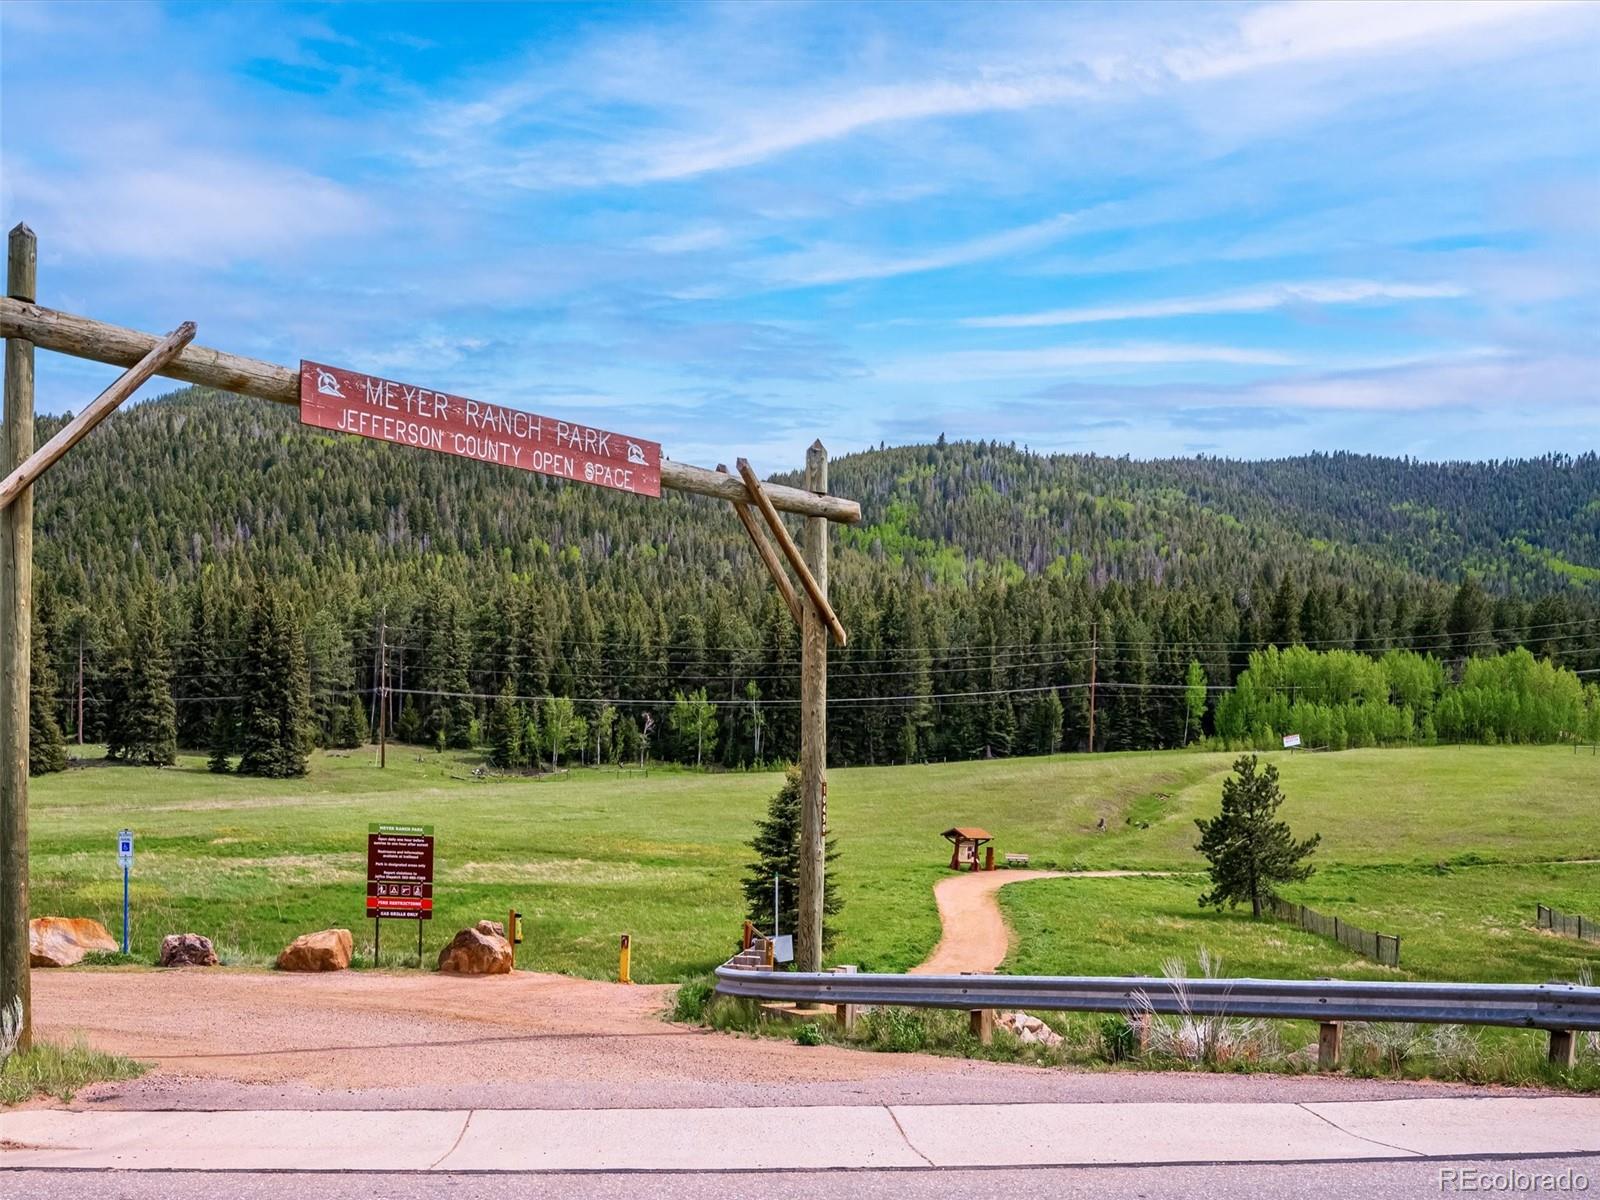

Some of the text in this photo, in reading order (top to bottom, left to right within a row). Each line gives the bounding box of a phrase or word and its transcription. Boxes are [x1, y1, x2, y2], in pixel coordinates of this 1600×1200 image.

[337, 408, 633, 490] JEFFERSON COUNTY OPEN SPACE
[365, 377, 611, 457] MEYER RANCH PARK
